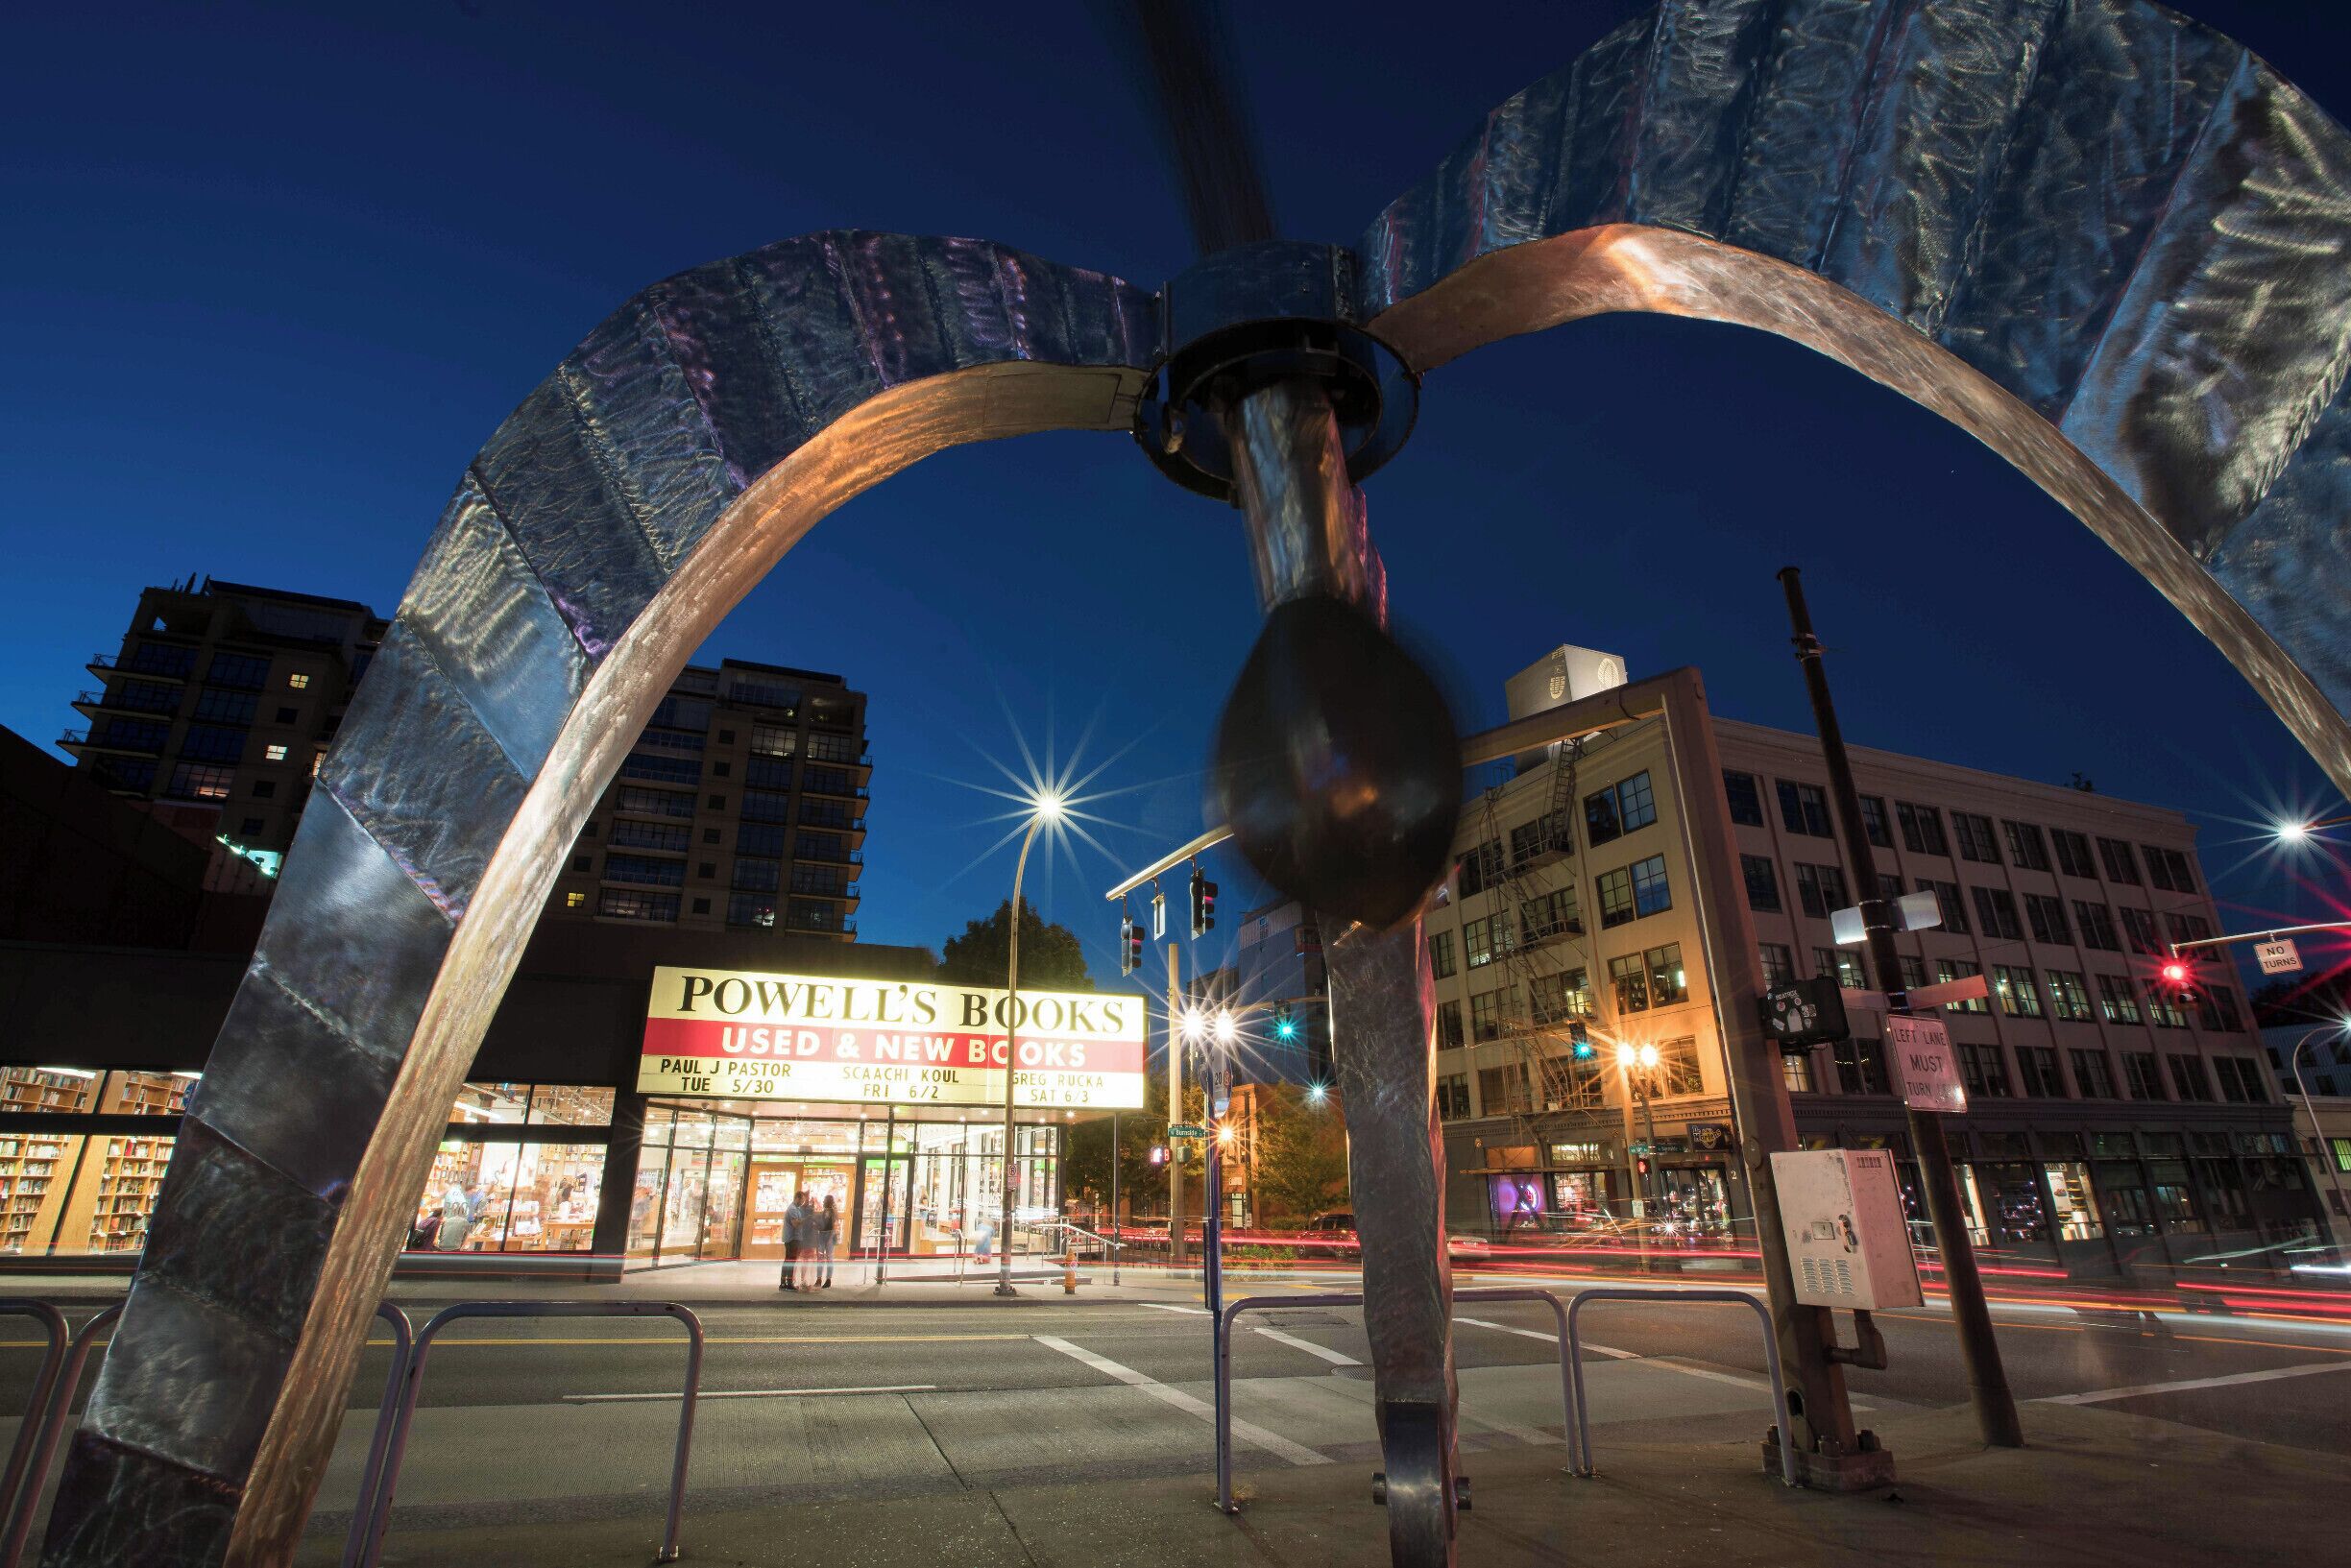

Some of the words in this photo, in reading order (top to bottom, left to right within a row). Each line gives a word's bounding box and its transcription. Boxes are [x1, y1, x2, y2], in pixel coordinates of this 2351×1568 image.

[2266, 946, 2285, 955] NO
[2264, 956, 2296, 968] TURNS
[677, 976, 936, 1025] POWELL'S
[958, 993, 1124, 1034] BOOKS
[1894, 1028, 1917, 1044] LEFT
[1923, 1030, 1947, 1046] LANE
[722, 1026, 820, 1055] USED
[836, 1033, 860, 1059] &
[875, 1034, 955, 1062] NEW
[968, 1039, 1086, 1067] BOOKS
[661, 1058, 702, 1074] PAUL
[710, 1060, 720, 1074] J
[728, 1061, 791, 1077] PASTOR
[1909, 1053, 1943, 1073] MUST
[843, 1066, 909, 1081] SCAACHI
[921, 1069, 959, 1083] KOUL
[1013, 1072, 1047, 1086] GREG
[1058, 1073, 1103, 1088] RUCKA
[1214, 1071, 1222, 1085] 20
[682, 1076, 711, 1092] TUE
[732, 1079, 774, 1094] 5/30
[864, 1083, 889, 1098] FRI
[909, 1085, 938, 1099] 6/2
[1906, 1081, 1931, 1097] TURN
[1030, 1088, 1056, 1102] SAT
[1064, 1090, 1089, 1103] 6/3
[1731, 1170, 1737, 1180] 2
